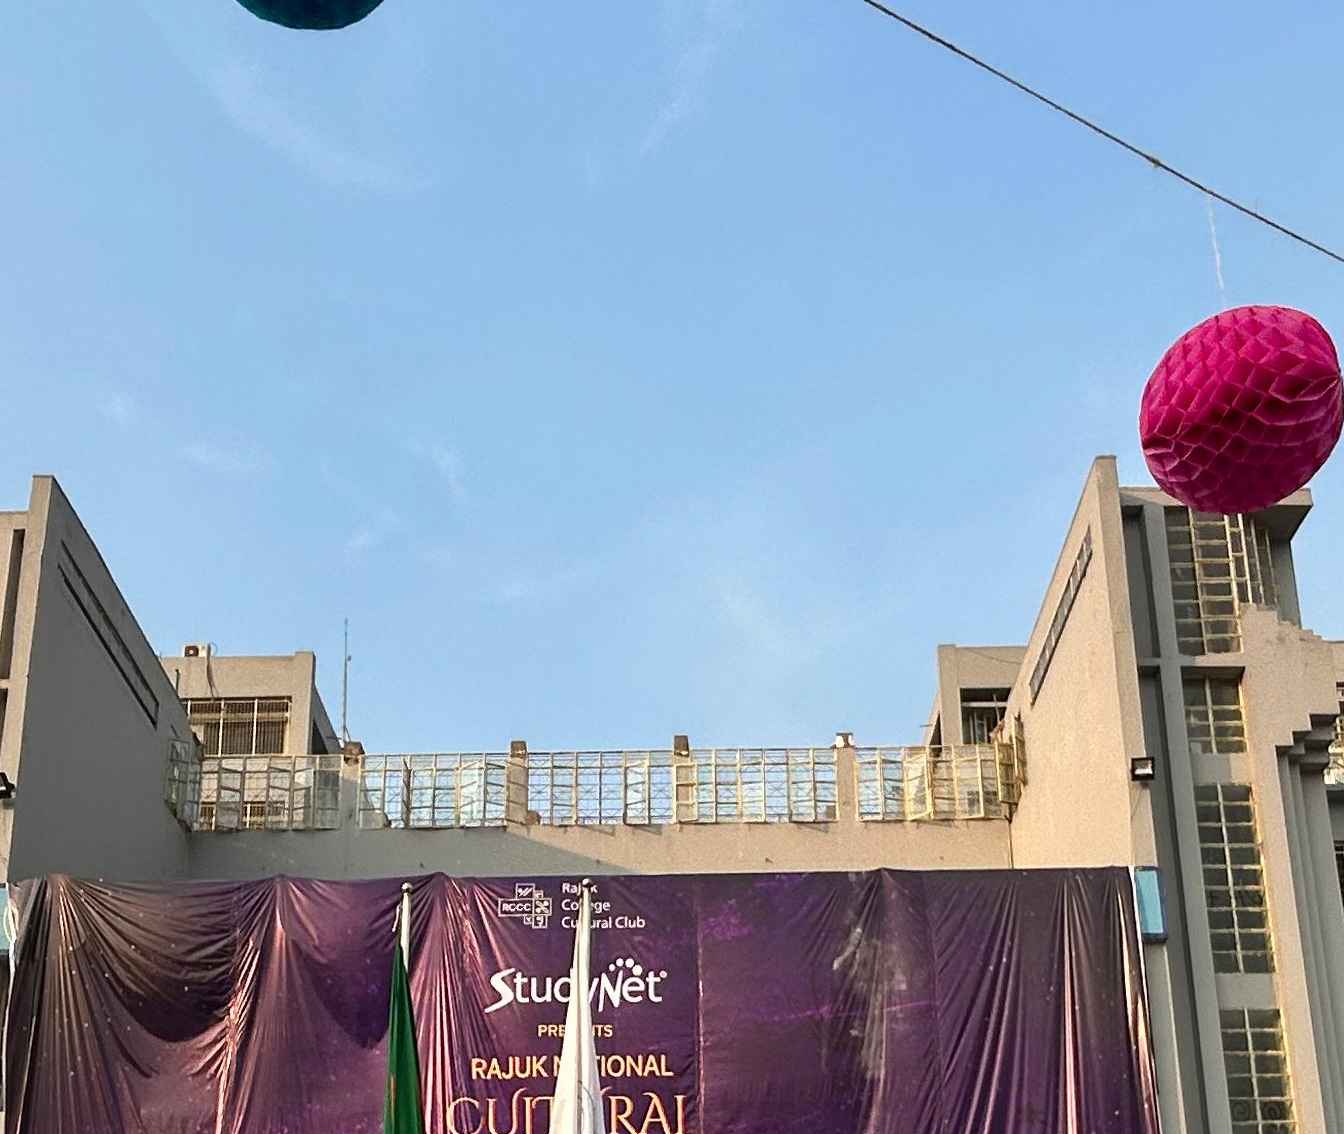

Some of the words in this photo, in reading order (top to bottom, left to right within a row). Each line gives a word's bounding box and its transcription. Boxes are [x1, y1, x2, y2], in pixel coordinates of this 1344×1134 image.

[562, 882, 598, 897] Rajk
[561, 899, 611, 913] Coge
[615, 916, 646, 929] Club
[471, 1055, 549, 1080] RAJUK
